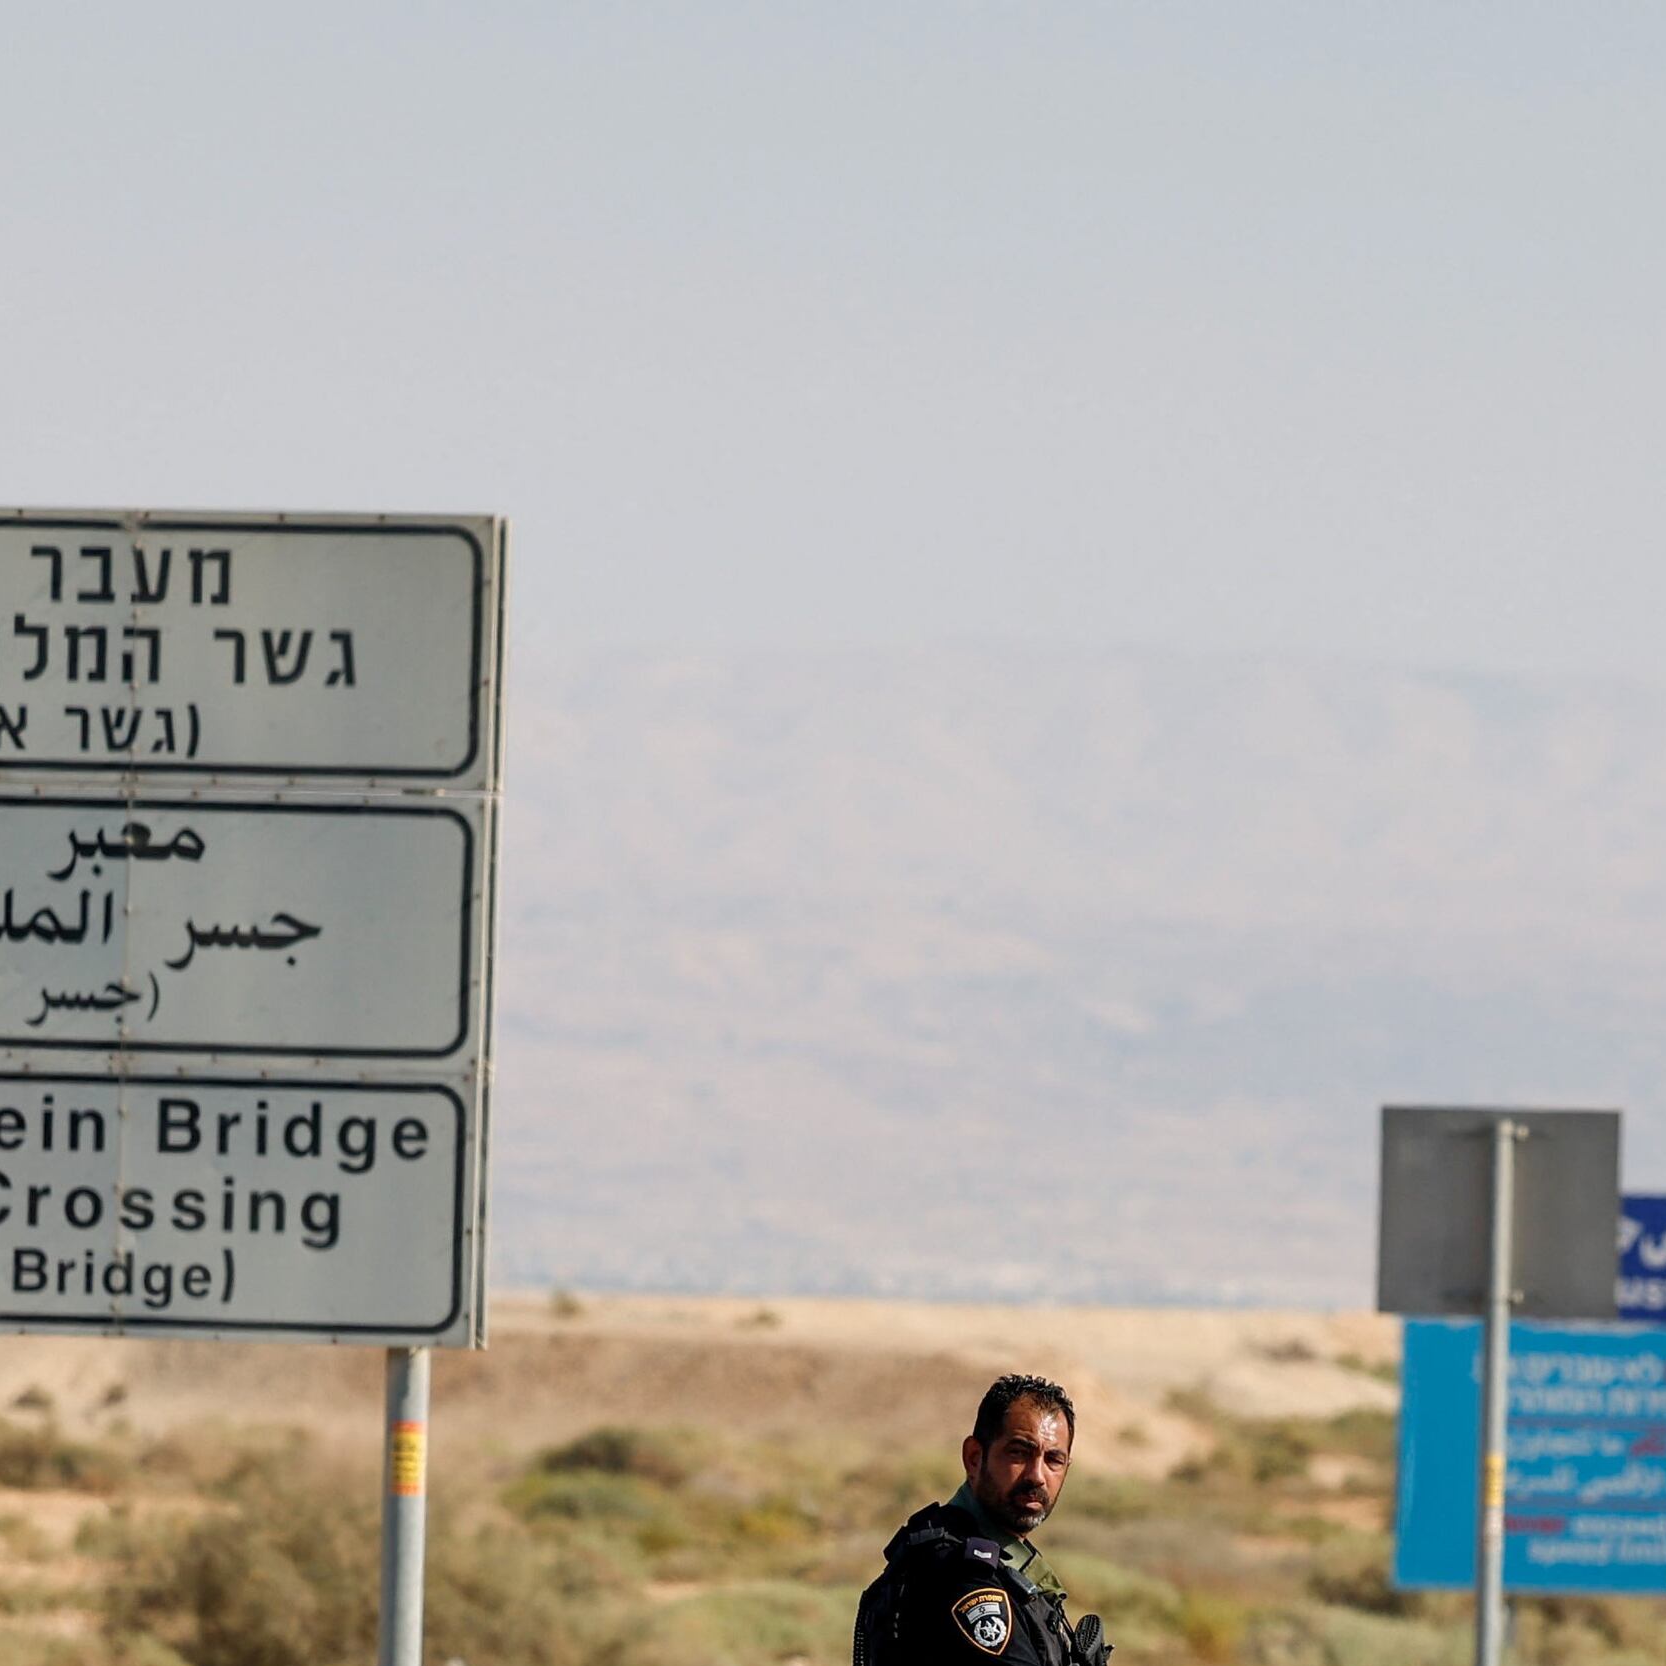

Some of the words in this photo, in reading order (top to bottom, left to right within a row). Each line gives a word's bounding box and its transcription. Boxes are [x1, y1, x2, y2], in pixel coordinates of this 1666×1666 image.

[30, 545, 231, 605] מעבר
[214, 629, 356, 687] גשר
[64, 703, 200, 759] (גשר
[45, 813, 205, 880] معبر
[166, 913, 322, 971] جسر
[27, 974, 159, 1027] (جسر
[157, 1098, 430, 1175] Bridge
[12, 1248, 235, 1309] Bridge)
